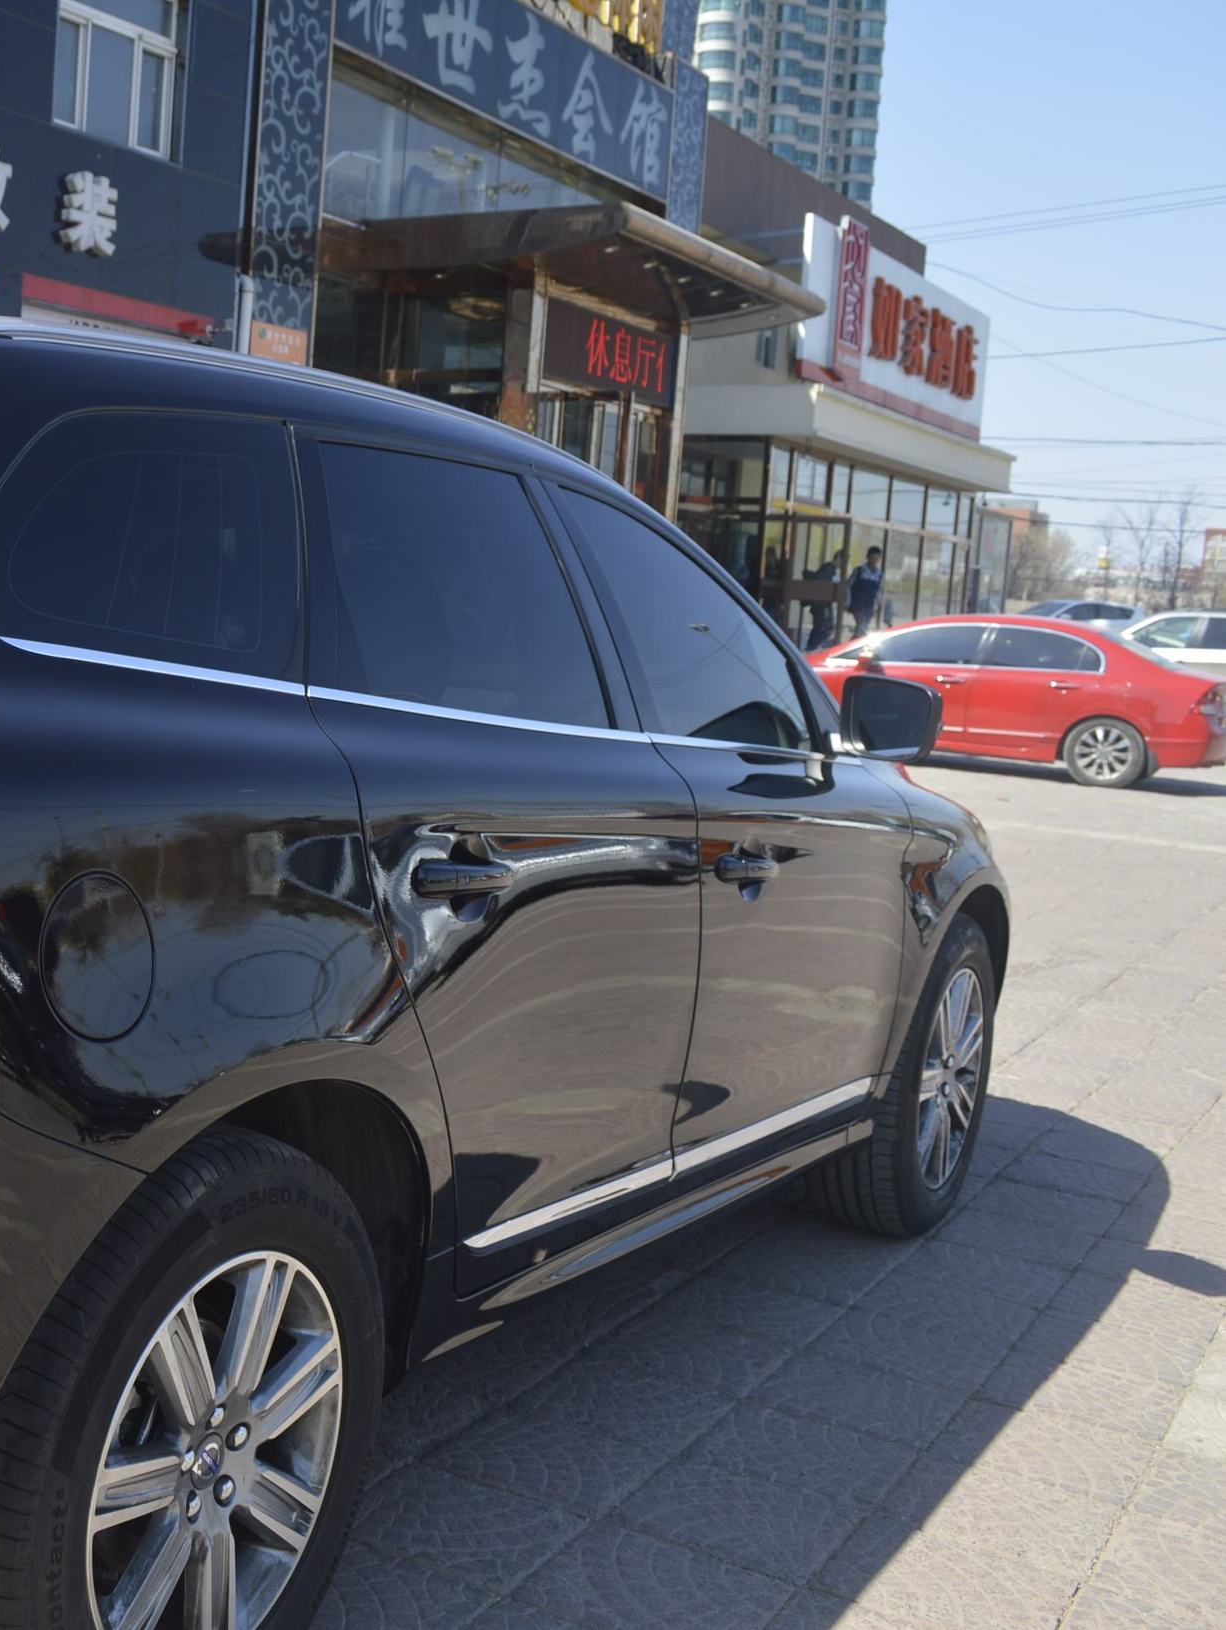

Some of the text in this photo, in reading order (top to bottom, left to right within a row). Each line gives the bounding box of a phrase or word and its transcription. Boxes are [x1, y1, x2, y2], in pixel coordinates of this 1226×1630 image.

[869, 275, 979, 401] 如家酒店
[220, 1187, 292, 1224] 235/60
